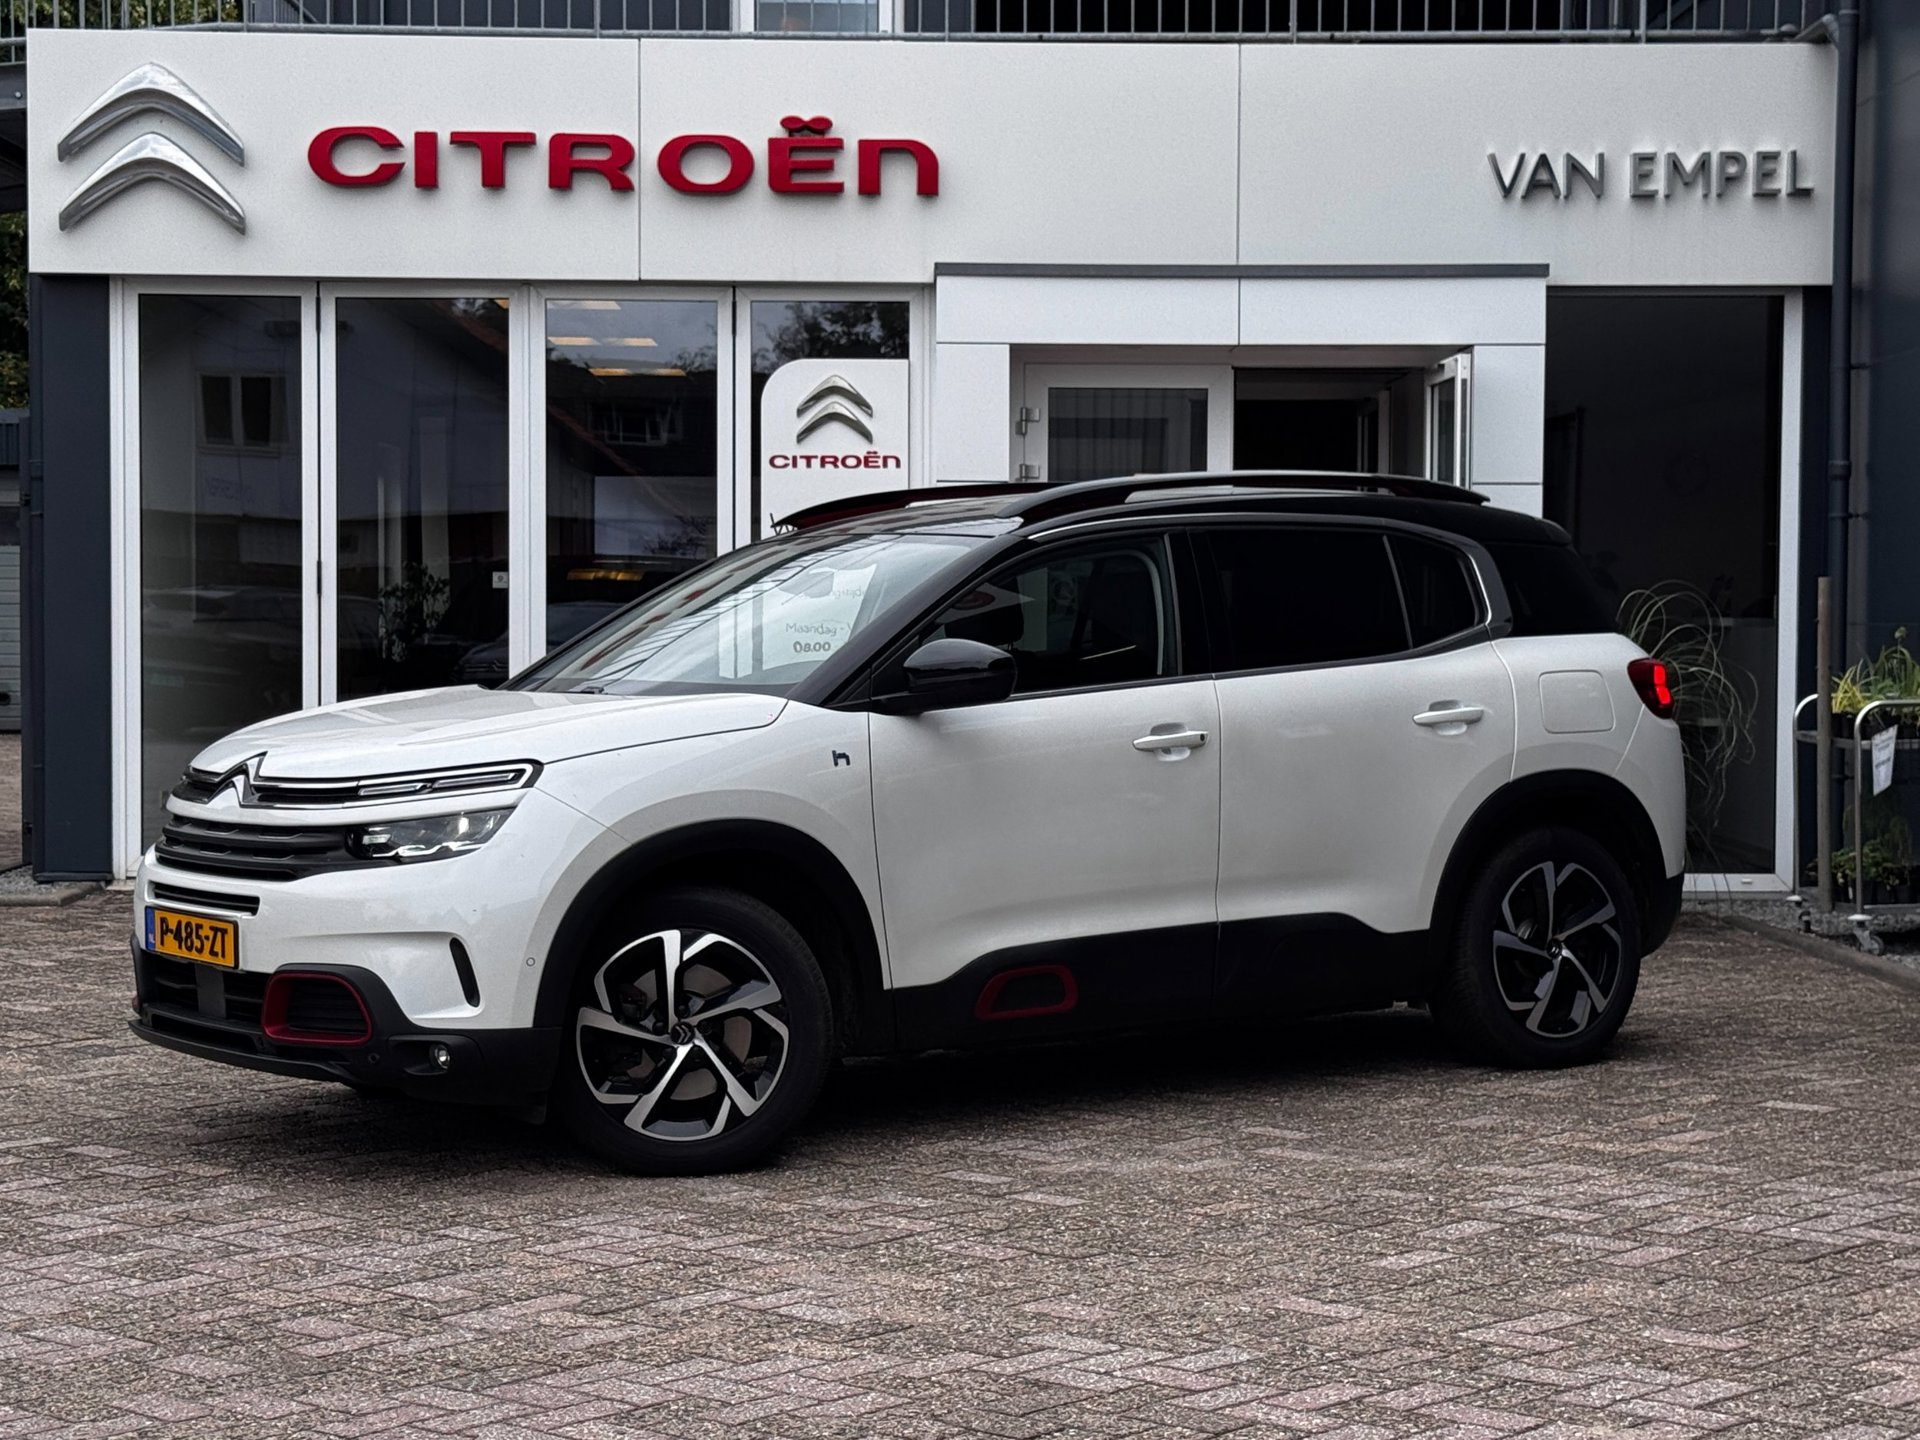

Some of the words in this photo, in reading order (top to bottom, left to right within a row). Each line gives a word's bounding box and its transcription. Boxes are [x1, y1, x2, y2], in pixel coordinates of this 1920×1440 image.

[308, 115, 940, 196] CITROËN
[1487, 151, 1605, 199] VAN
[1629, 149, 1815, 199] EMPEL
[768, 451, 902, 469] CITROËN
[160, 916, 228, 959] P-485-ZT
